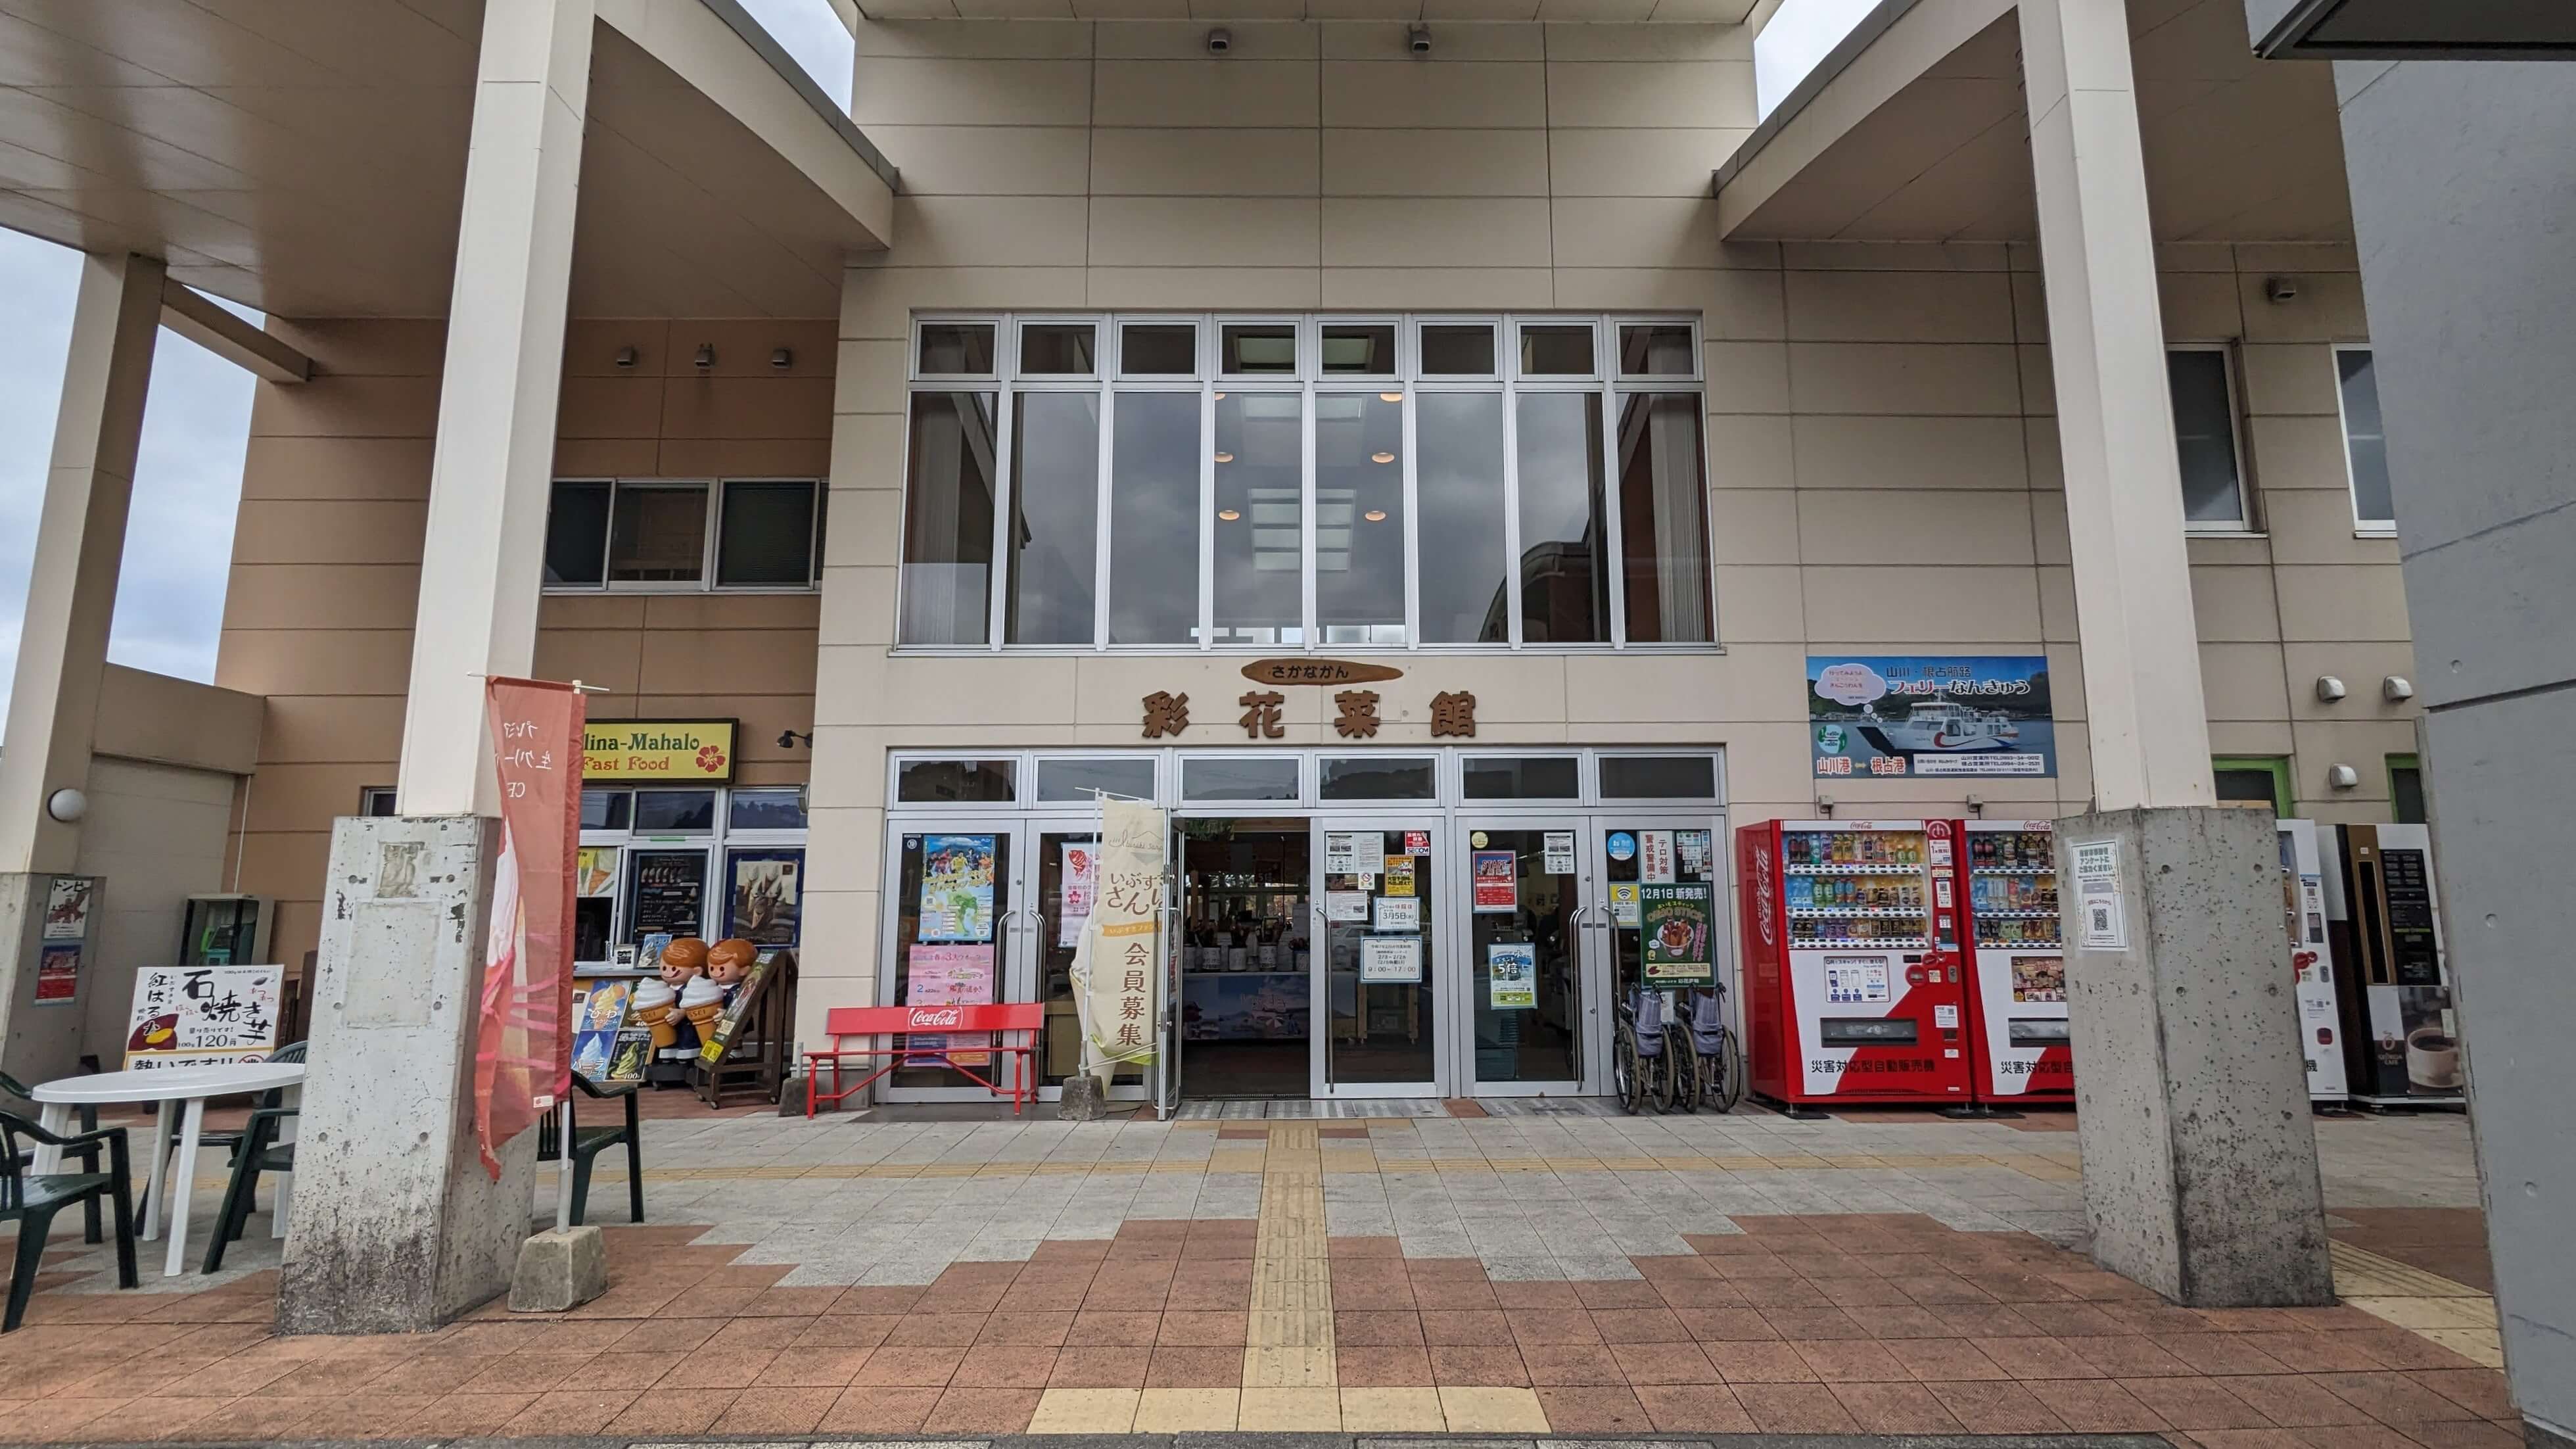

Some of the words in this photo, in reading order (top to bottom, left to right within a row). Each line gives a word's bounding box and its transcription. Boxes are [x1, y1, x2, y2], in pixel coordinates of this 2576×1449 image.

[1271, 665, 1349, 678] さかなかん
[1888, 679, 2031, 695] フェリーなんきゅう
[1142, 690, 1476, 738] 彩花菜館
[583, 756, 620, 771] Fast
[627, 755, 670, 771] Food
[1818, 757, 1850, 774] 山川港
[1871, 757, 1905, 775] 根占港
[2024, 820, 2051, 830] Coca-Cola
[1658, 839, 1669, 875] テロ対策
[1641, 888, 1674, 899] 12月1日
[1675, 888, 1707, 899] 新発売!
[1755, 844, 1773, 946] Coca-Cola
[1498, 962, 1518, 974] 5倍
[1115, 942, 1150, 1047] 会員募集
[144, 972, 168, 1036] 紅はるか
[588, 1009, 617, 1018] びわ
[911, 1010, 960, 1026] Coca-Cola
[196, 1034, 237, 1047] 120円
[571, 1060, 605, 1070] バニラ
[1812, 1060, 1936, 1074] 災害対応型自動販売機
